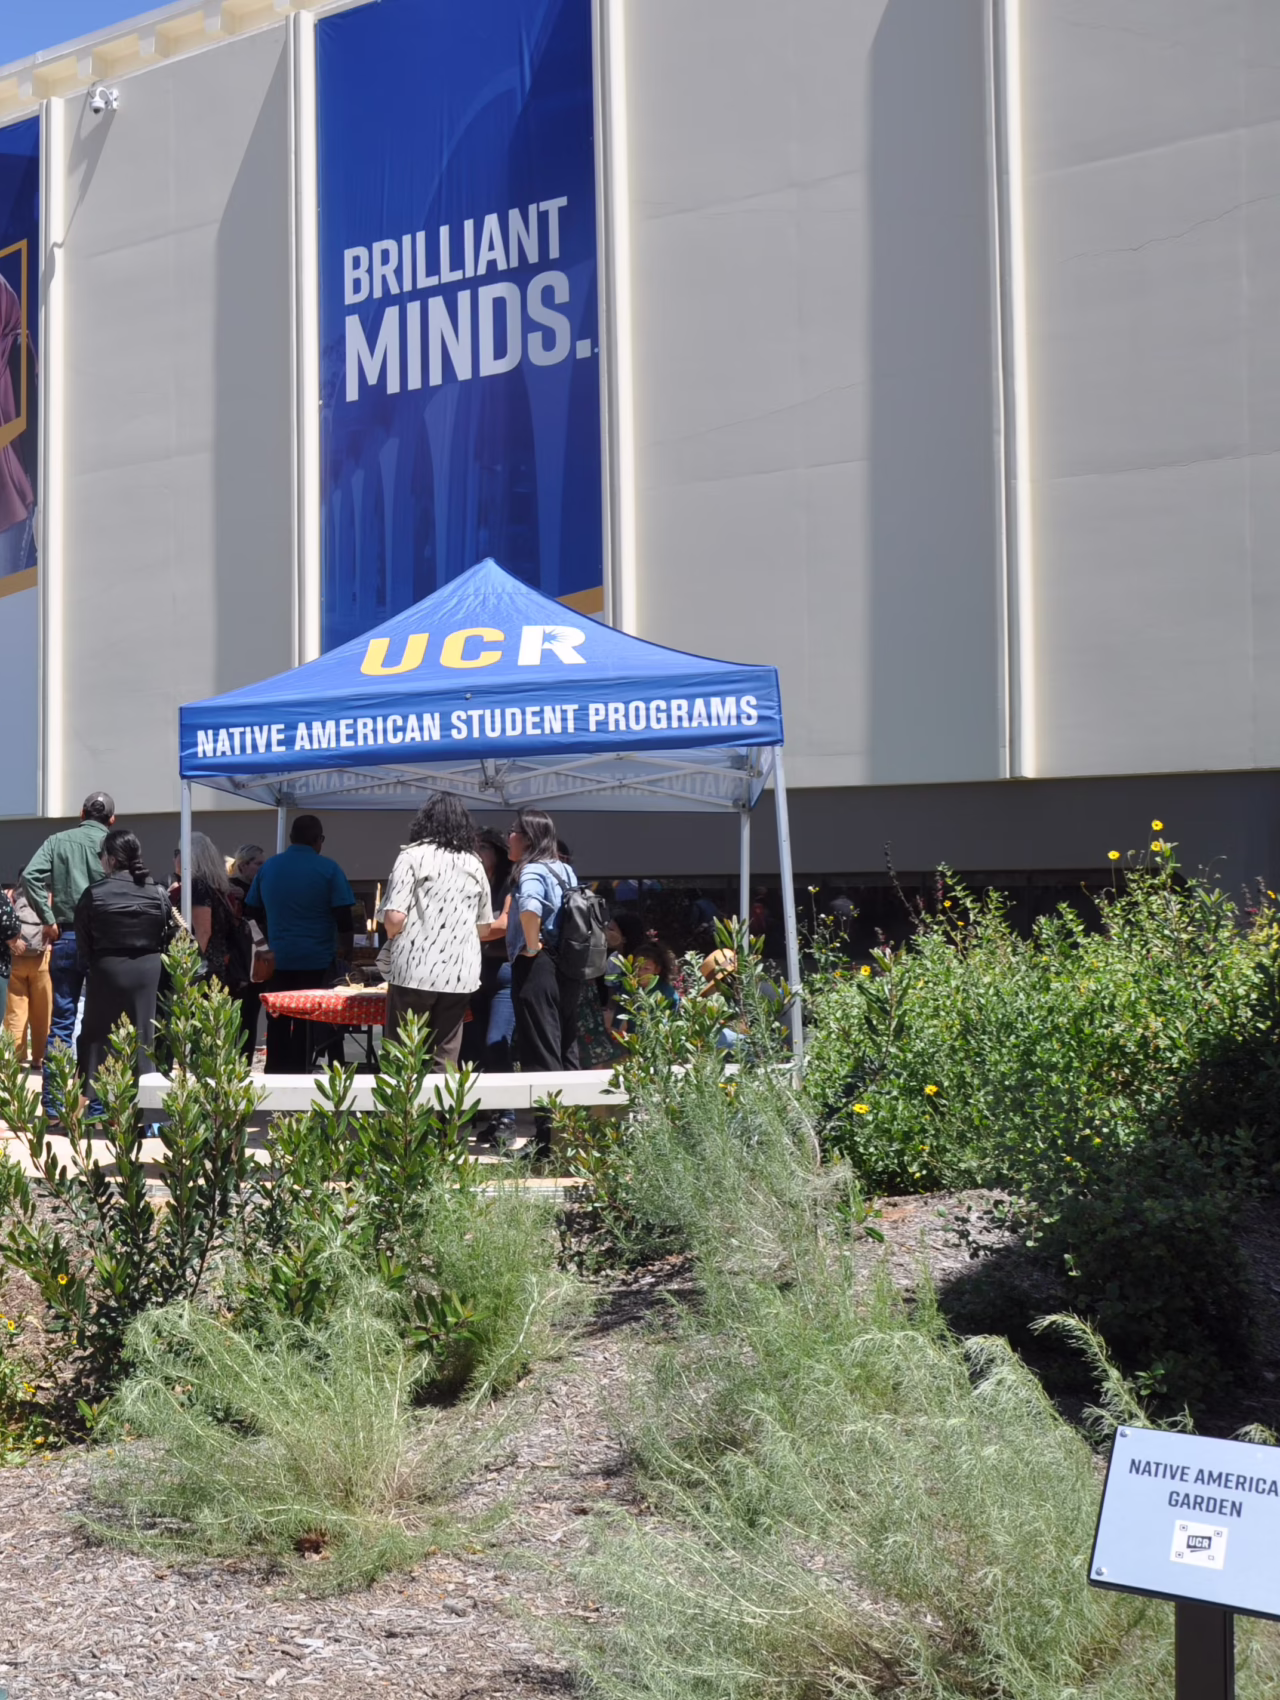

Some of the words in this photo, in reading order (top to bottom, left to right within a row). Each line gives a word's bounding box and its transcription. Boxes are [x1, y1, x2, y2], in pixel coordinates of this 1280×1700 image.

[344, 196, 568, 306] BRILLIANT
[345, 270, 592, 403] MINDS.
[360, 625, 587, 676] UCR
[197, 723, 287, 758] NATIVE
[294, 712, 441, 751] AMERICAN
[450, 704, 579, 739] STUDENT
[588, 695, 759, 733] PROGRAMS
[1129, 1458, 1191, 1483] NATIVE
[1193, 1468, 1279, 1498] AMERICA
[1168, 1490, 1243, 1518] GARDEN
[1188, 1535, 1211, 1549] UCR
